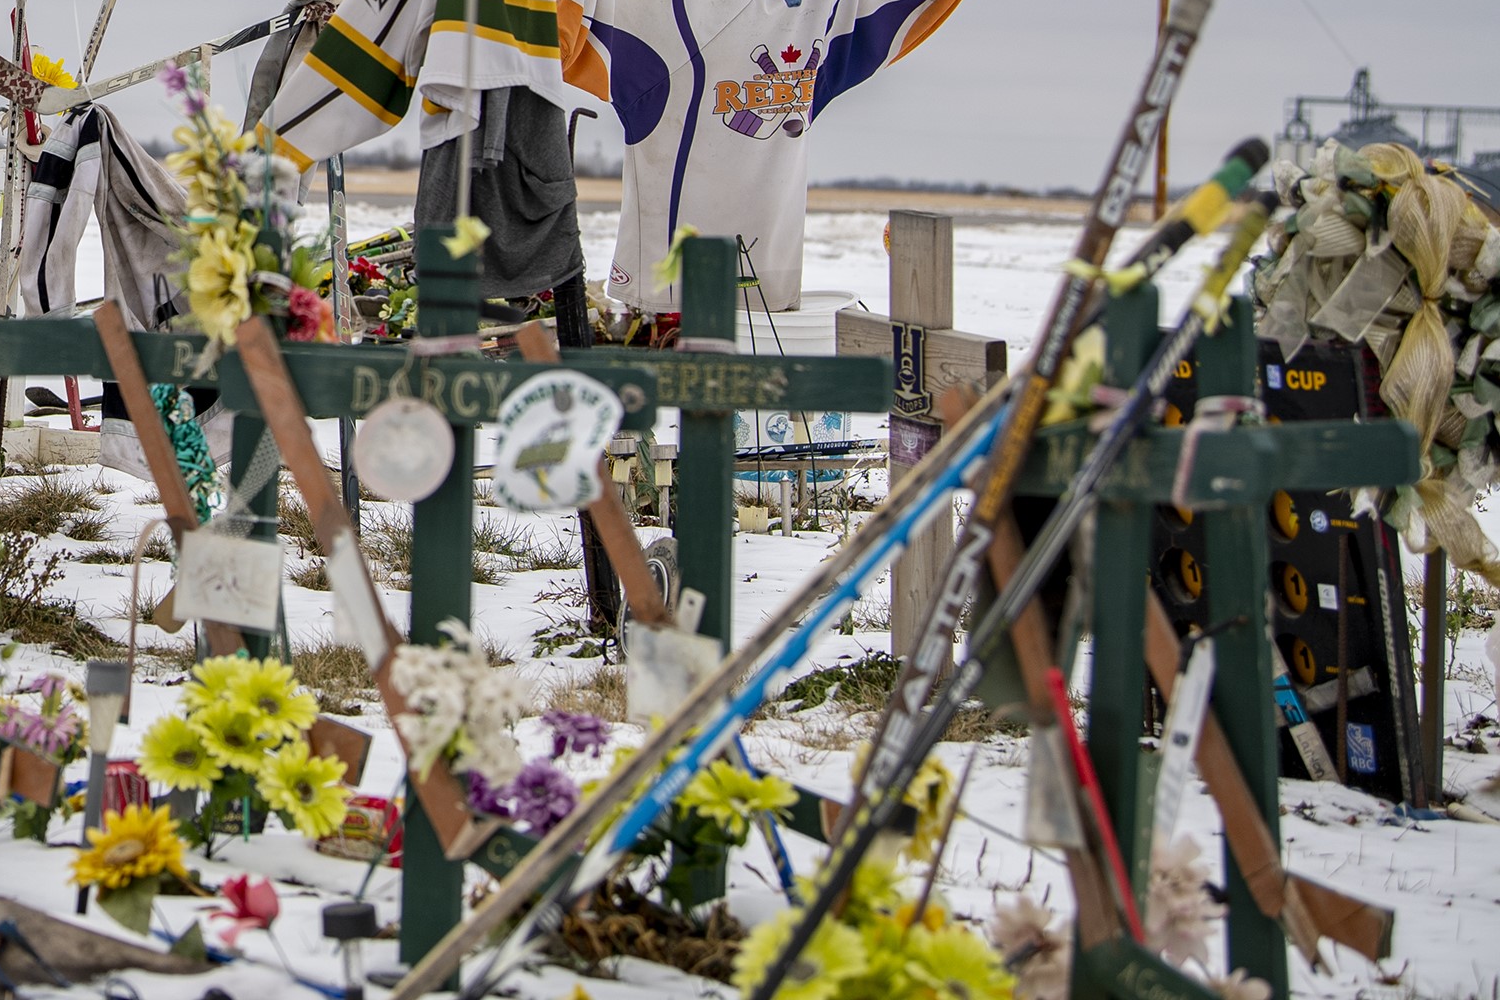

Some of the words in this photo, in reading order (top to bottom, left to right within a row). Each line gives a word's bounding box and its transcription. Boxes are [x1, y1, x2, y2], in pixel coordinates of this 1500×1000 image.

[1286, 369, 1327, 391] CUP
[353, 365, 511, 418] DARCY
[1351, 757, 1375, 771] RBC
